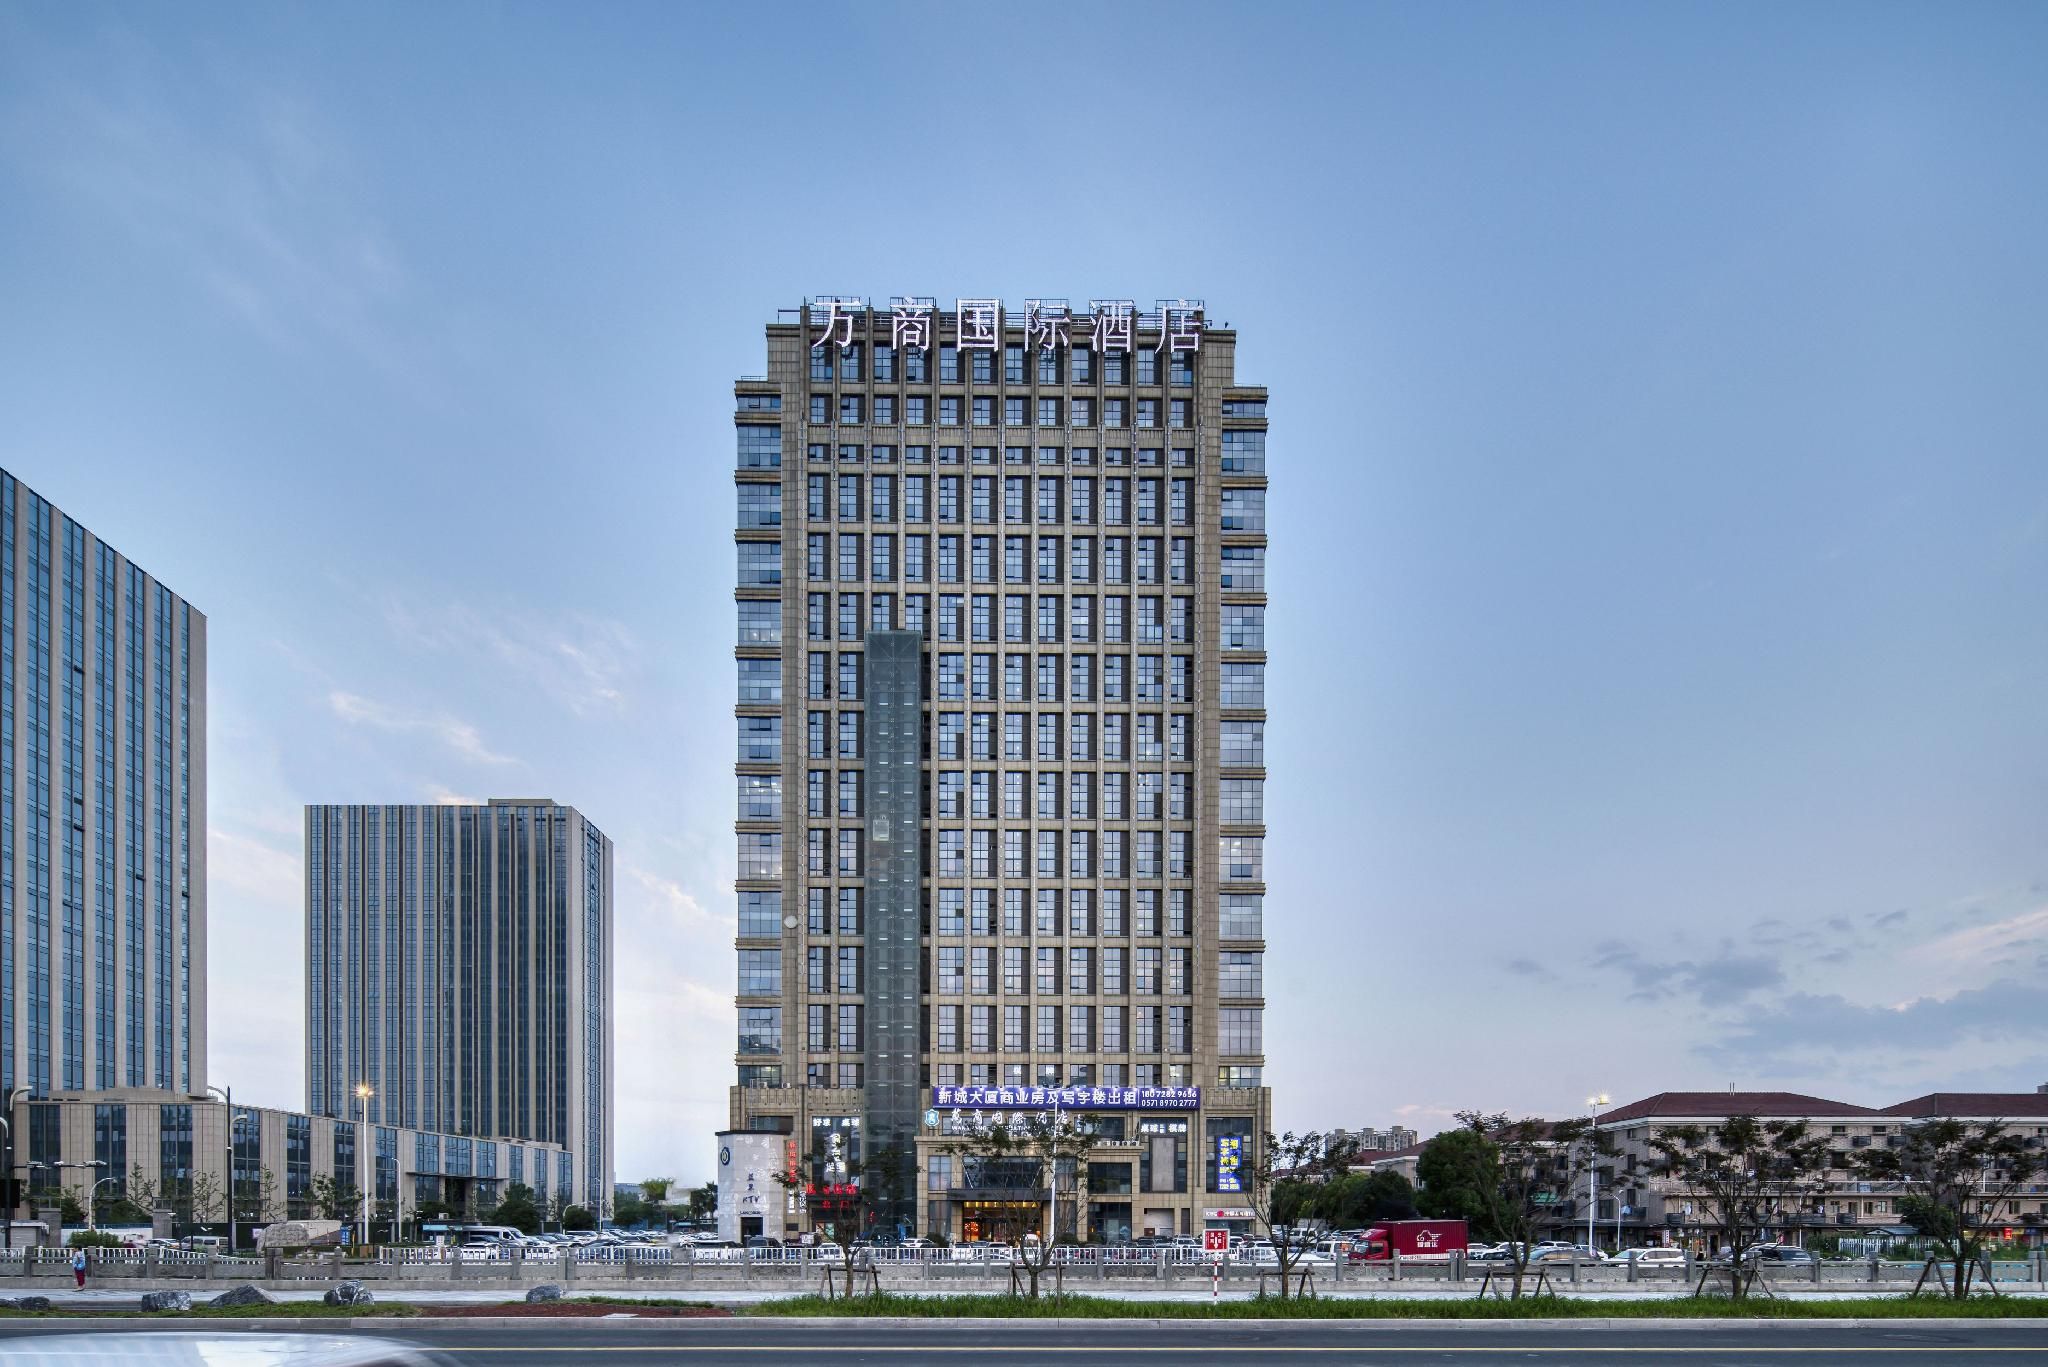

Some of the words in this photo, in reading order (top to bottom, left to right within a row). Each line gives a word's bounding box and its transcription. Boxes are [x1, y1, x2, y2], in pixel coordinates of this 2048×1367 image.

[812, 296, 1205, 353] 万商国际酒店
[938, 1089, 1137, 1105] 新城大厦商业房及写字楼出租
[1156, 1090, 1176, 1098] 7282
[1141, 1099, 1158, 1107] 0571
[1159, 1099, 1178, 1107] 8970
[1179, 1099, 1197, 1107] 2777
[742, 1194, 761, 1204] KTV
